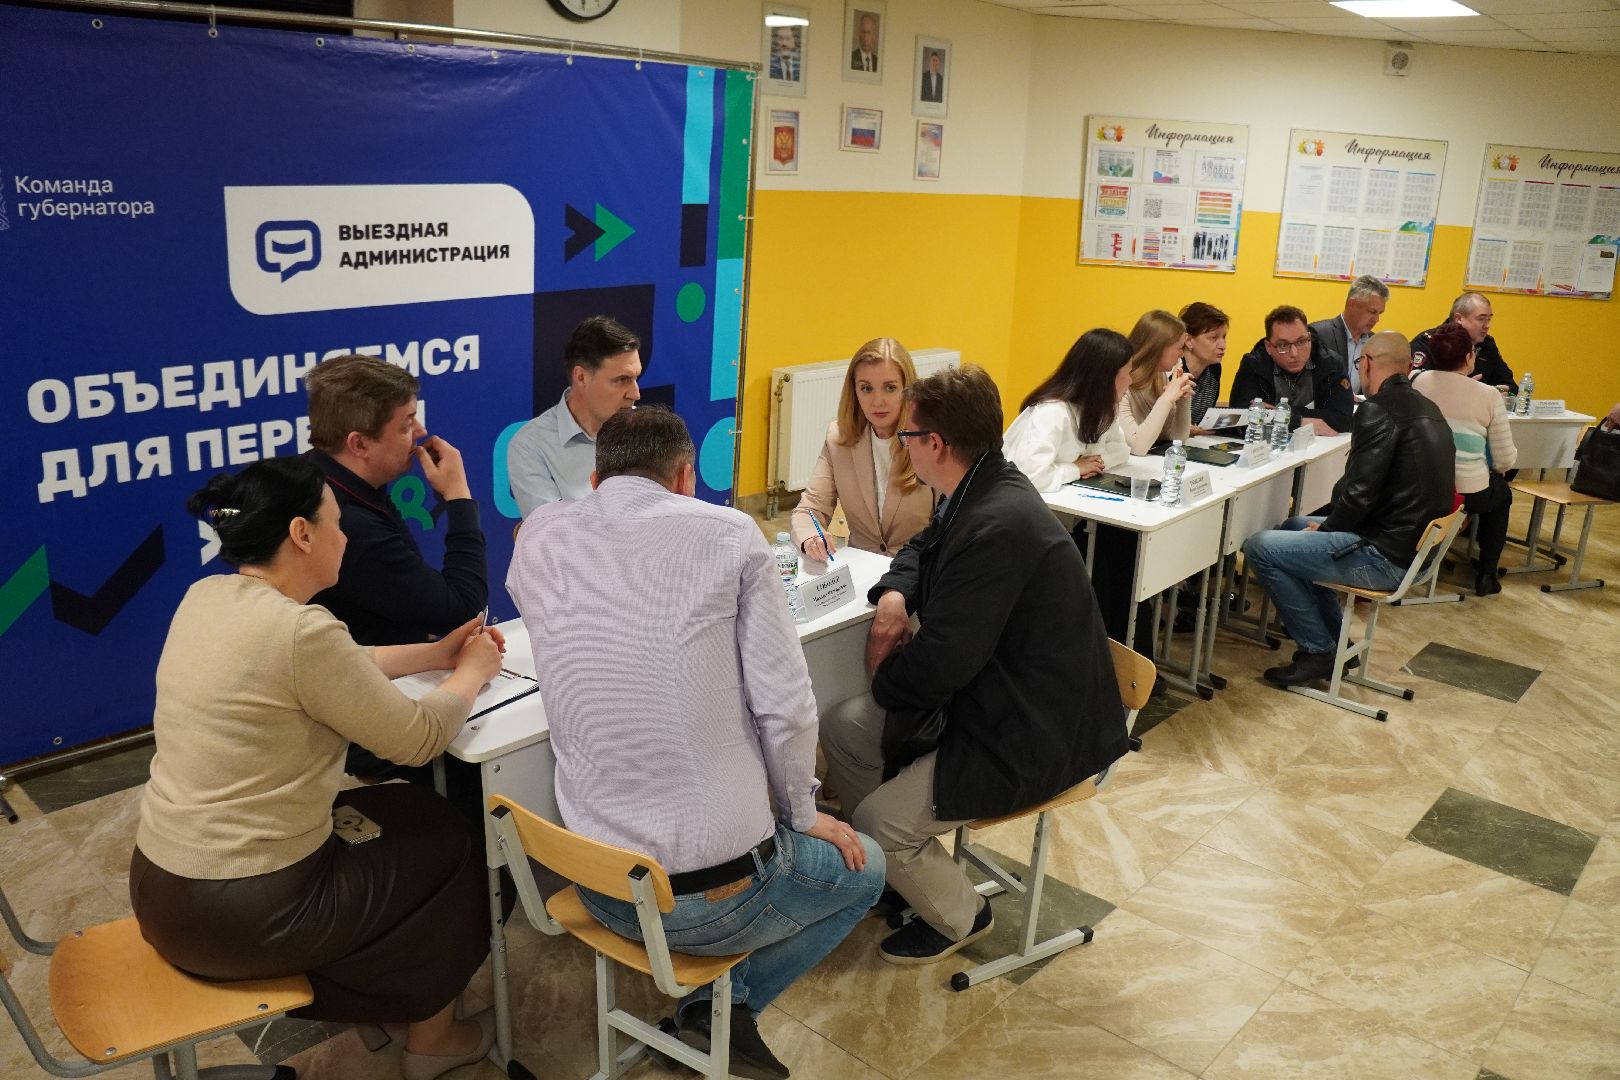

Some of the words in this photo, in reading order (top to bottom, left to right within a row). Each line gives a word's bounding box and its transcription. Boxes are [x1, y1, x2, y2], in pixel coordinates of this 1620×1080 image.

[1145, 123, 1235, 148] Информация
[1345, 139, 1432, 165] Информация
[15, 176, 113, 196] Команда
[18, 199, 155, 221] губернатора
[338, 222, 448, 241] ВЫЕЗДНАЯ
[339, 244, 510, 270] АДМИНИСТРАЦИЯ
[27, 334, 480, 424] ОБЪЕДИНМСЯ
[37, 435, 172, 504] ДЛЯ
